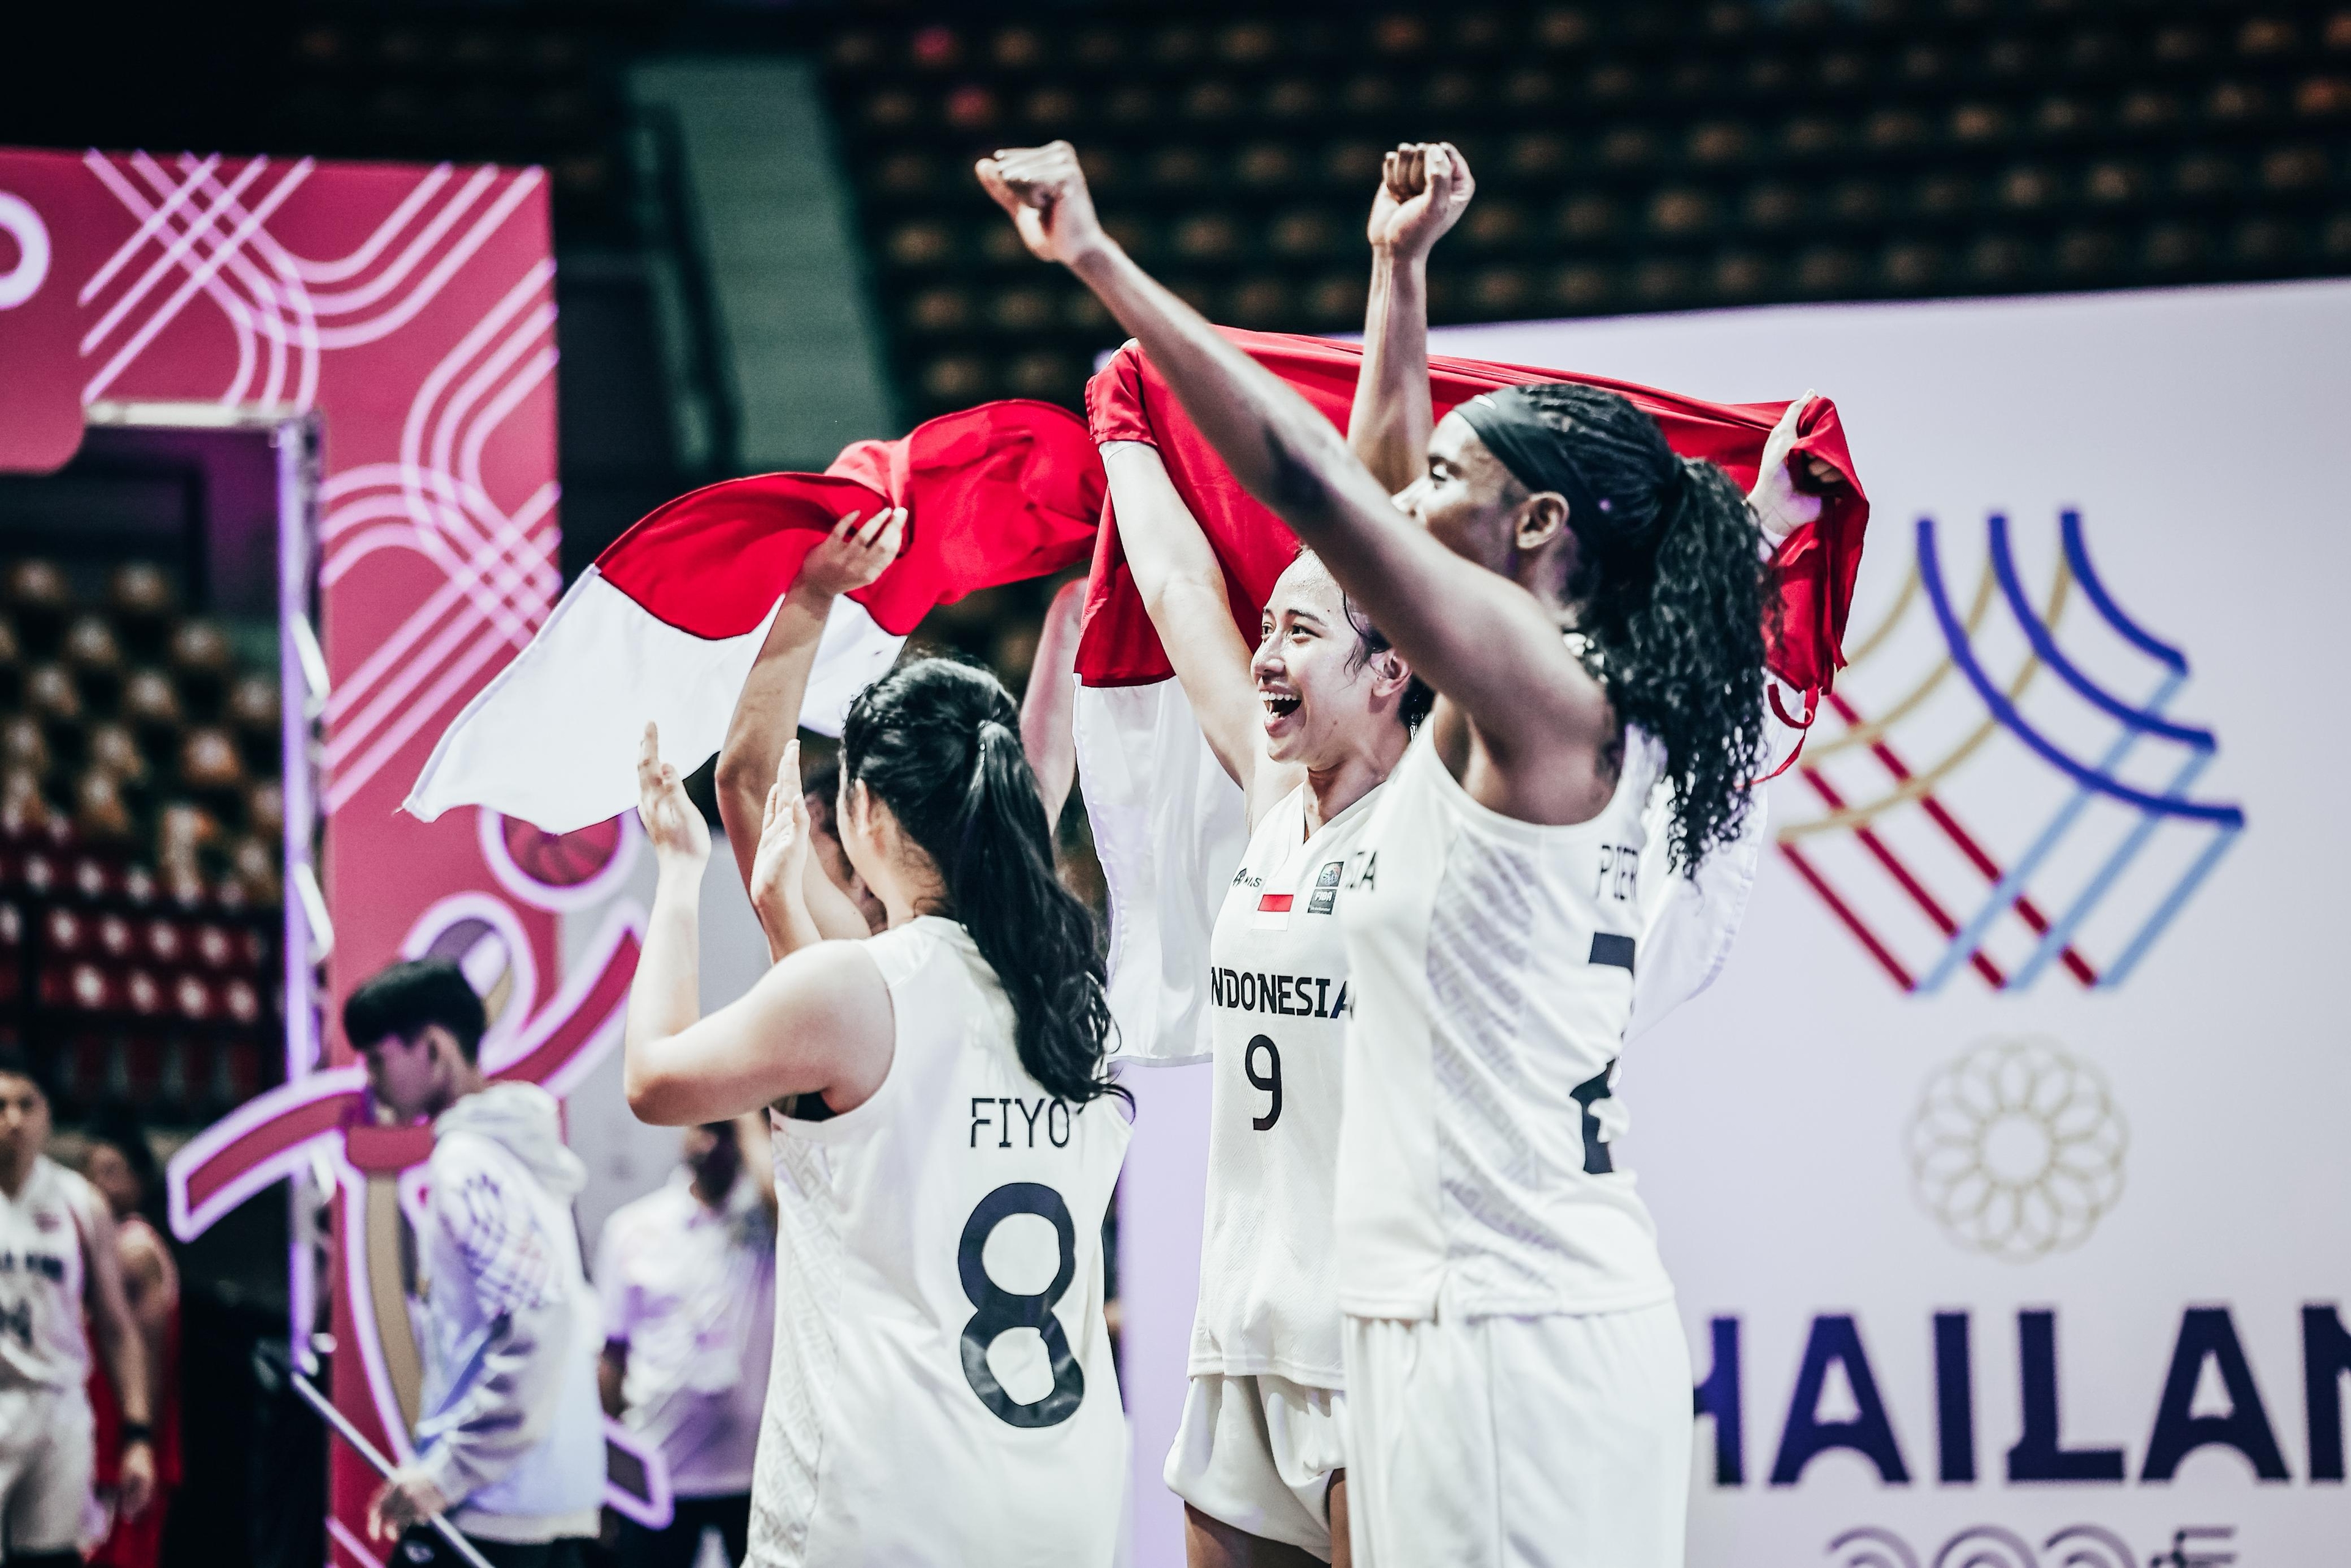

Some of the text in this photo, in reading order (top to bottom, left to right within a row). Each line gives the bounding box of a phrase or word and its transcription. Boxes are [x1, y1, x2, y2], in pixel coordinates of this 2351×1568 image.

[1314, 890, 1333, 902] FIBA
[1245, 1033, 1283, 1131] 9
[970, 1098, 1069, 1148] FIYO
[958, 1182, 1085, 1429] 8
